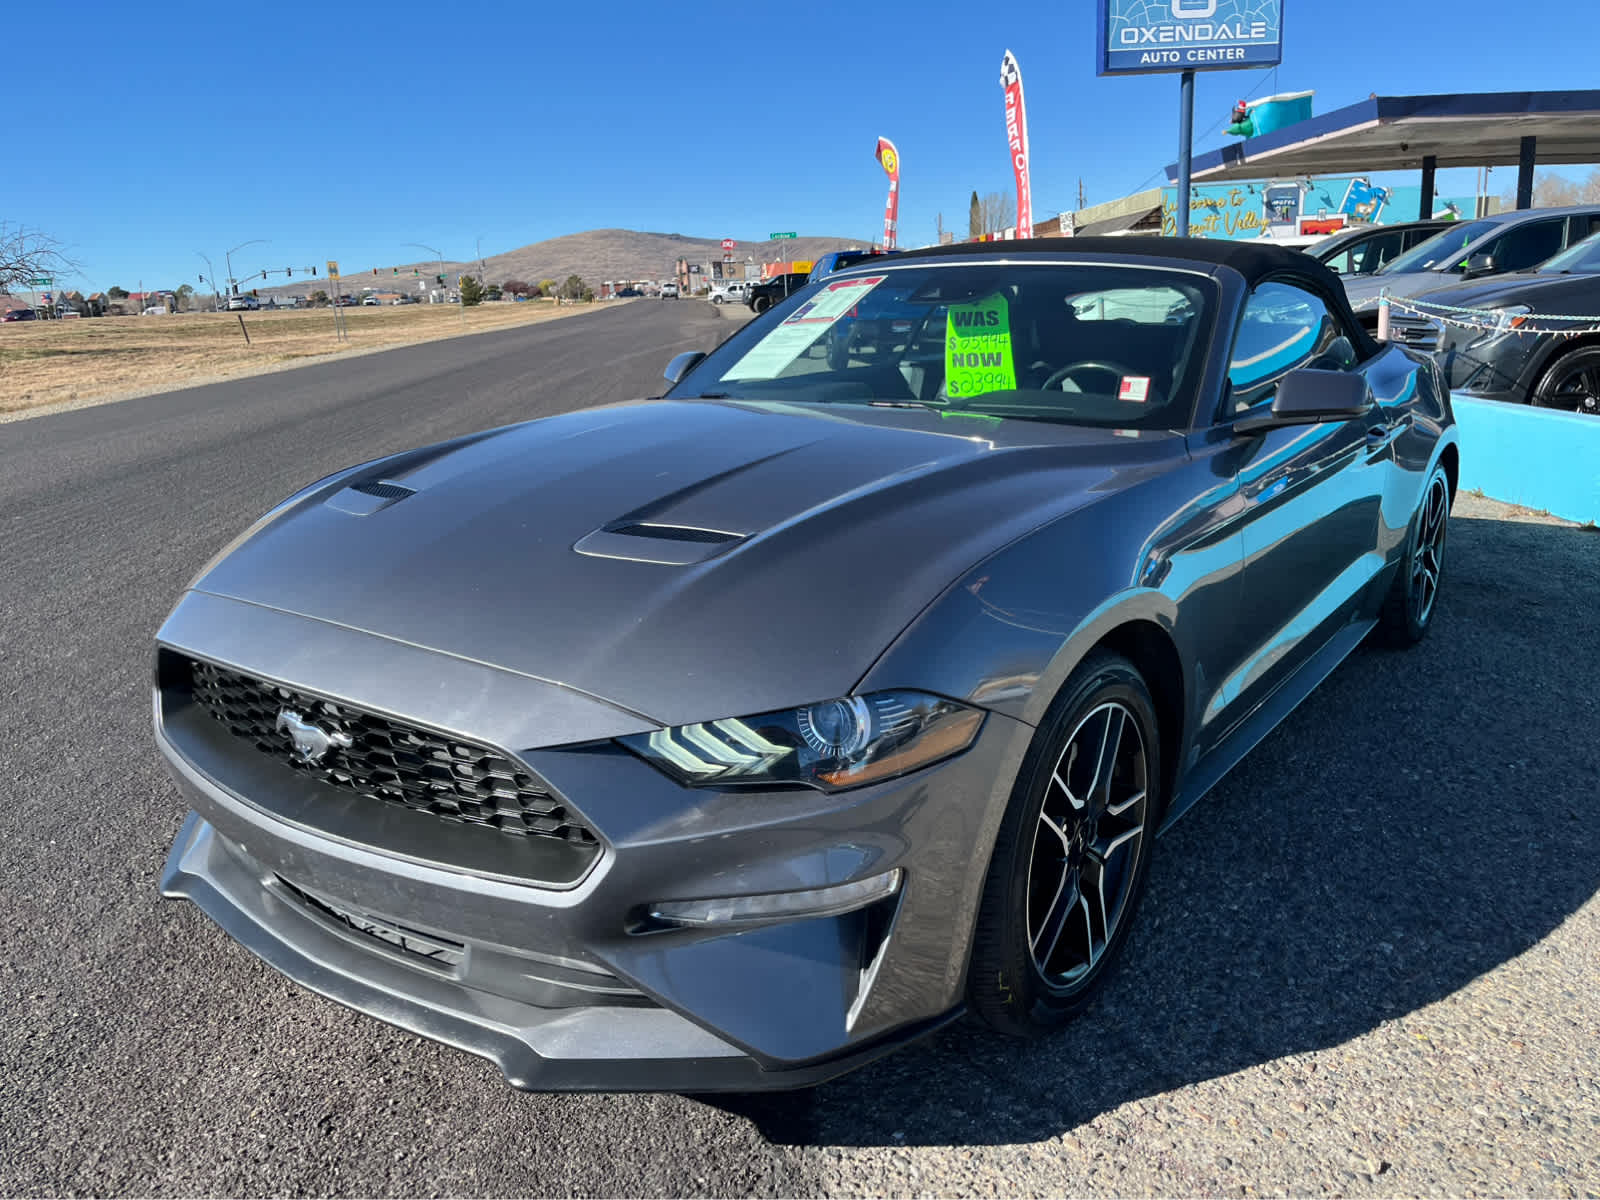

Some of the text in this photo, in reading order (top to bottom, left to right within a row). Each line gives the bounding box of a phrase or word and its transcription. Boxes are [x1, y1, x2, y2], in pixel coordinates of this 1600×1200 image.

[1120, 22, 1267, 44] OXENDALE
[1140, 48, 1246, 64] AUTO CENTER
[1228, 188, 1246, 207] to
[954, 310, 1000, 328] WAS
[952, 352, 1002, 368] NOW
